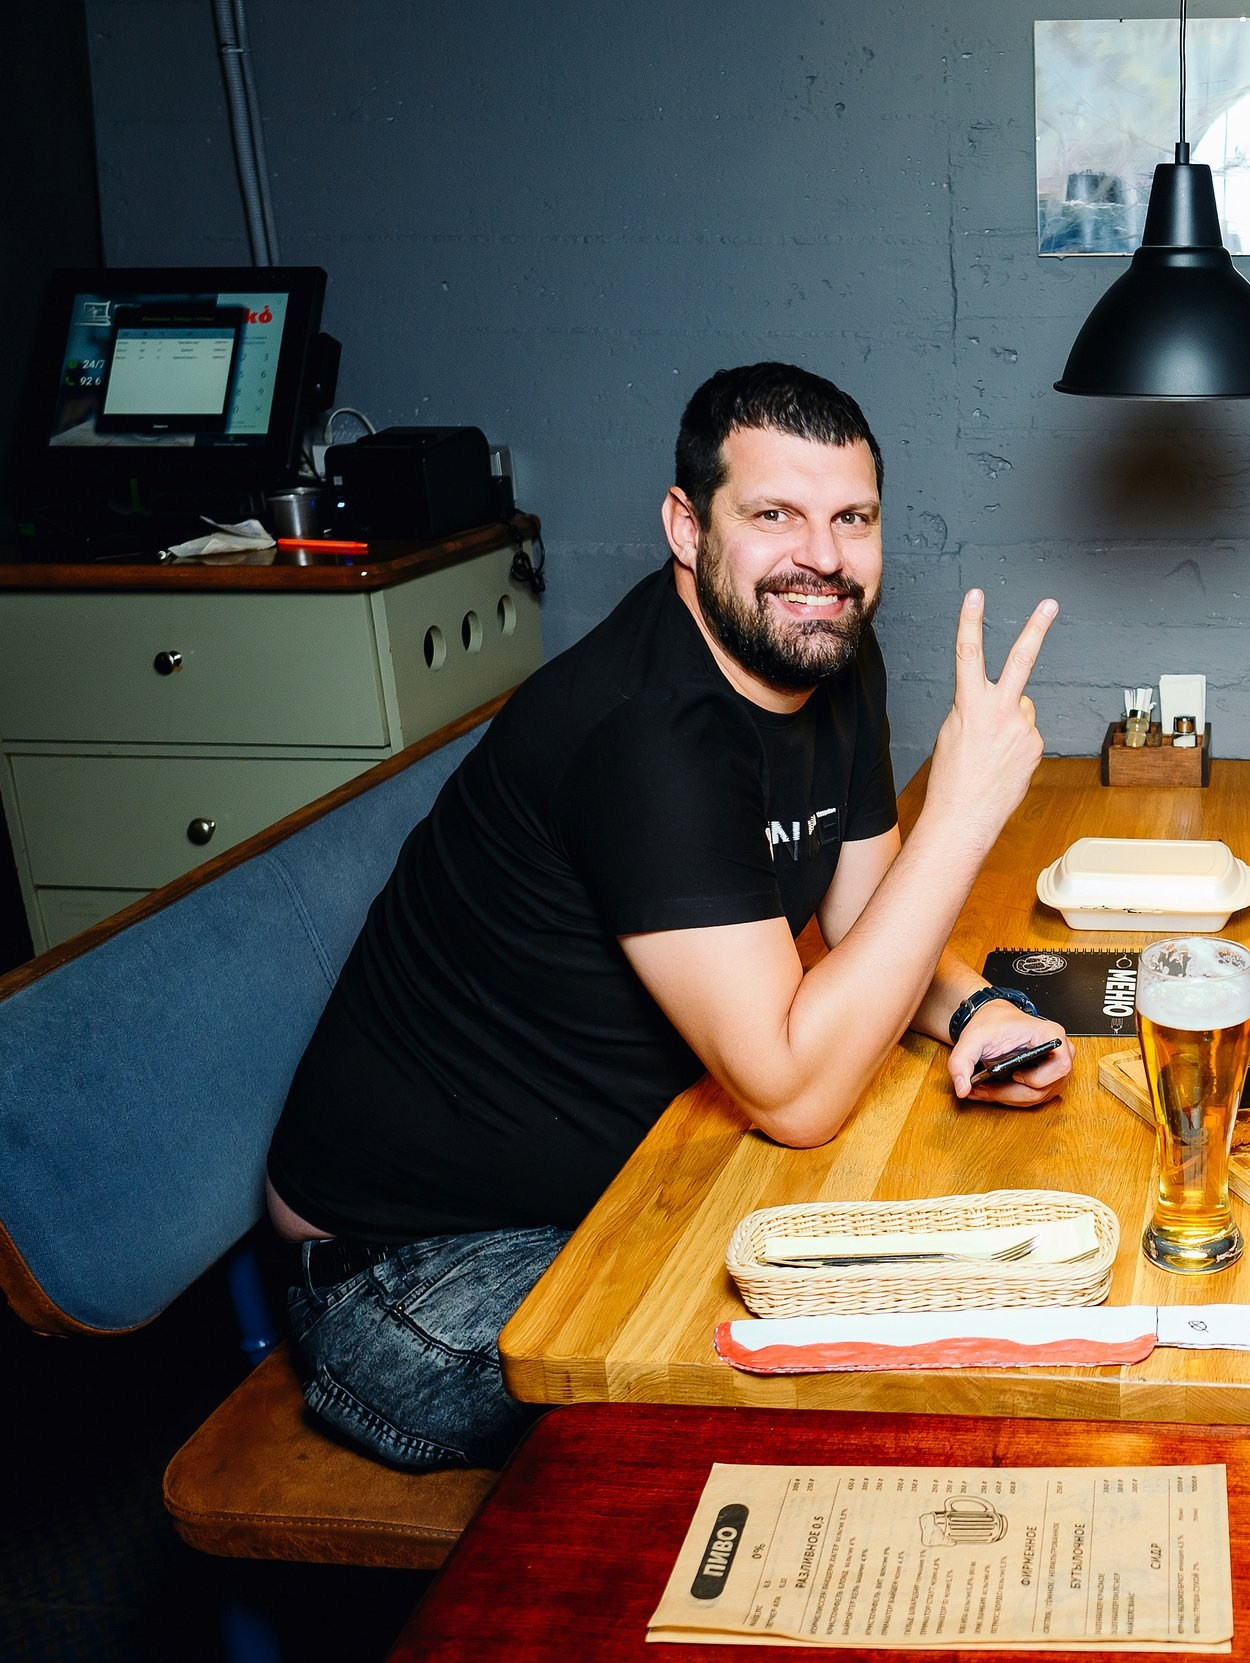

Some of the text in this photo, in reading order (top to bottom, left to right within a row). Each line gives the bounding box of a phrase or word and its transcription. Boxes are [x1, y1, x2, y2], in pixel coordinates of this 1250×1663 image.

[1102, 969, 1137, 1017] МЕНЮ
[704, 1527, 737, 1576] ПИВО
[751, 1543, 765, 1559] 0%
[795, 1516, 824, 1588] РАЗЛИВНОЕ 0,5
[1021, 1526, 1037, 1586] ФИРМЕННОЕ
[1070, 1524, 1085, 1588] БУТЫЛОЧНОЕ
[1150, 1543, 1161, 1569] СИДР
